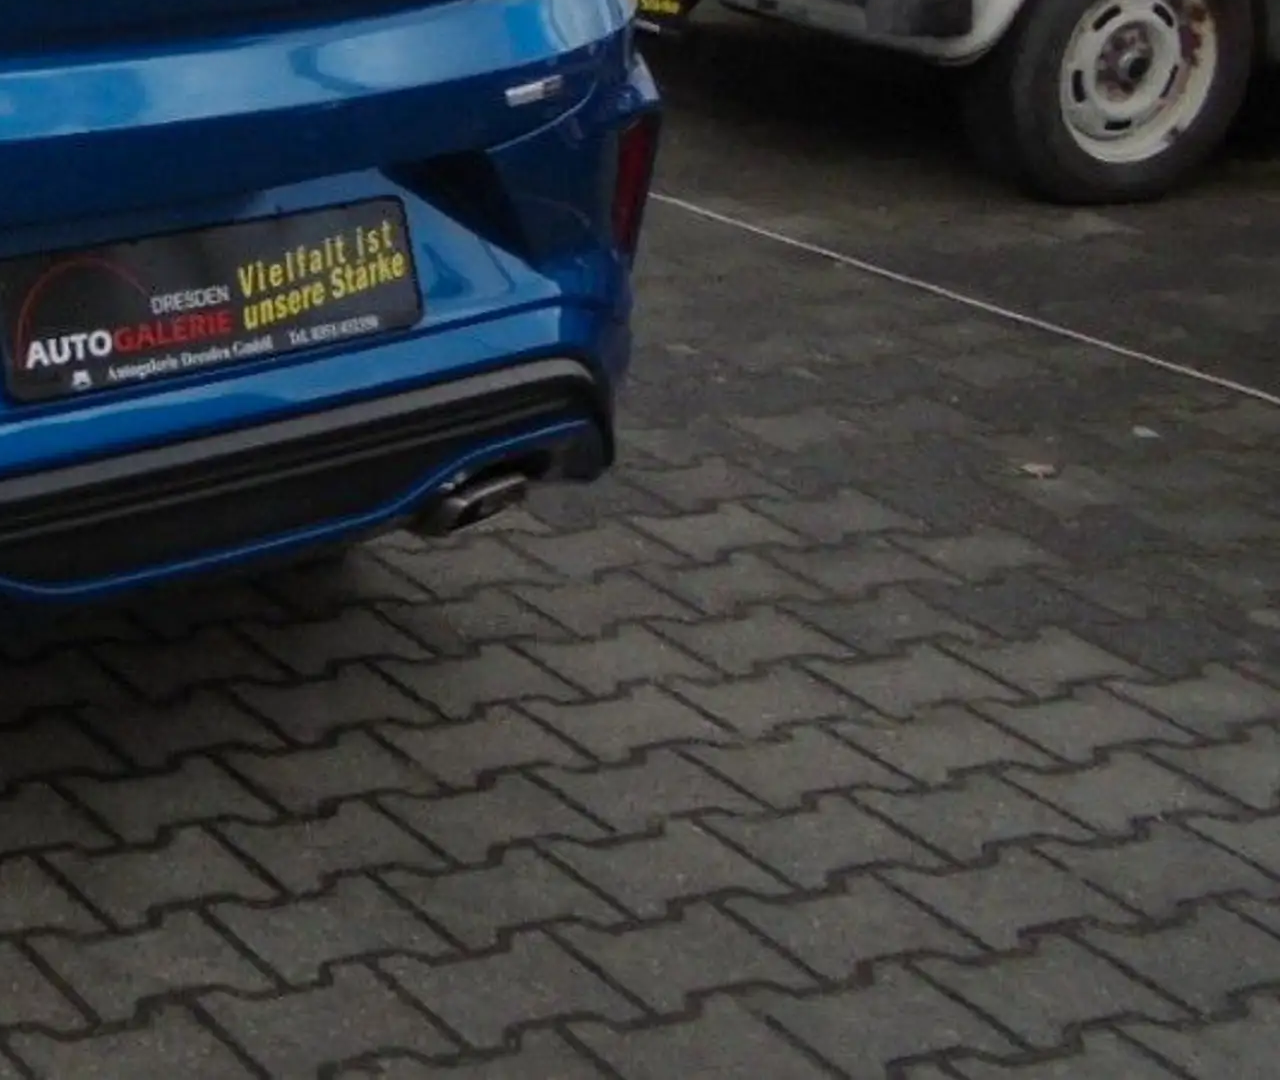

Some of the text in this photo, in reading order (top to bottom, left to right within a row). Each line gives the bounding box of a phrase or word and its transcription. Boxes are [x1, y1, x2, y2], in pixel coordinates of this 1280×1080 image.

[238, 220, 393, 298] Vielfalt ist
[150, 285, 230, 314] DRESDEN
[243, 281, 326, 330] unsere
